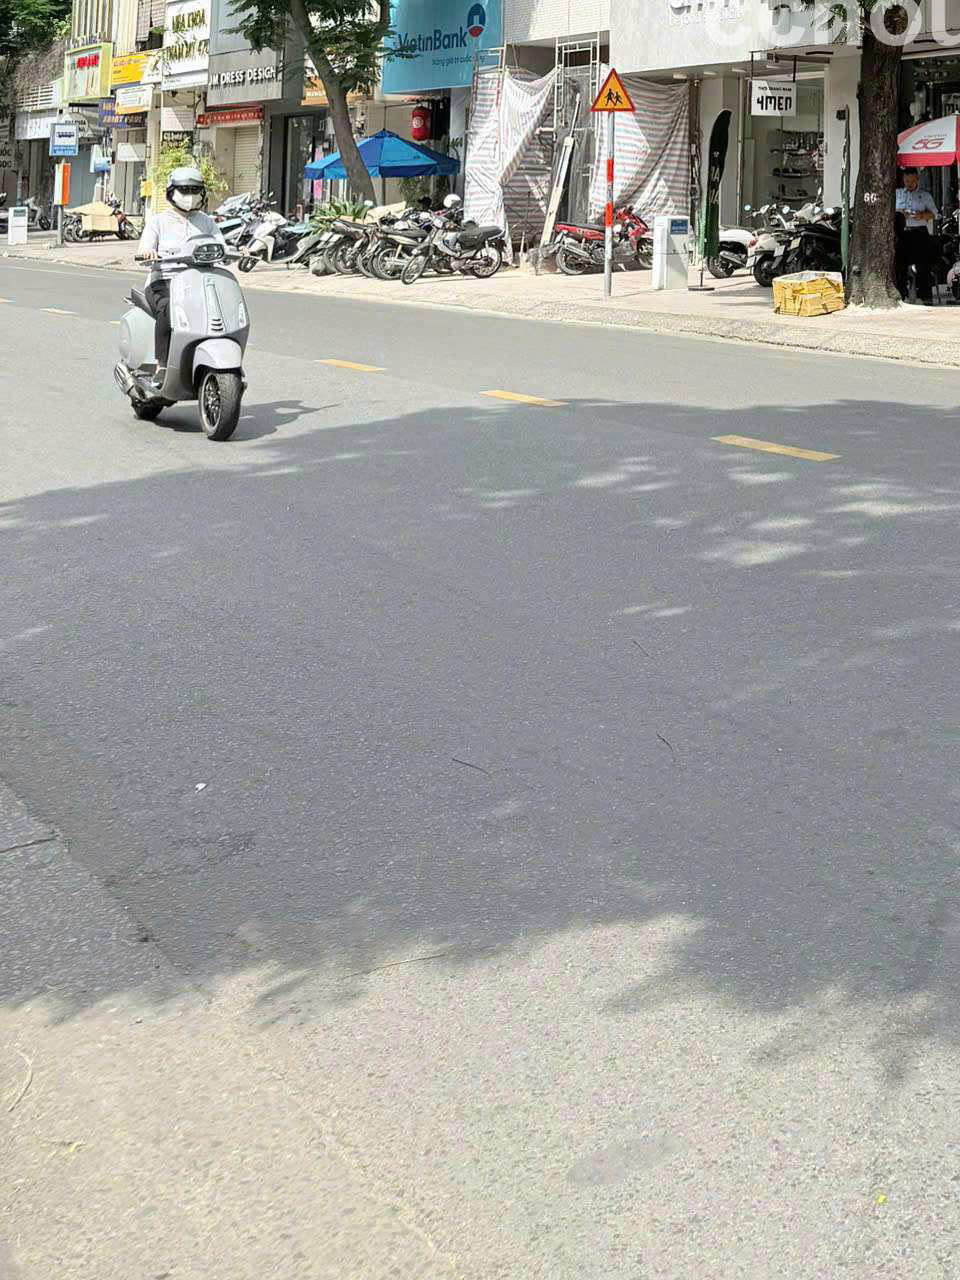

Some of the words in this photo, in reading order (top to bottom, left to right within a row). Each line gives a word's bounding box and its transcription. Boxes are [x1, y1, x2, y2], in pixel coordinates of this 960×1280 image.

[398, 26, 468, 53] VietinBank
[220, 70, 244, 84] DRESS
[247, 66, 276, 81] DESIGN
